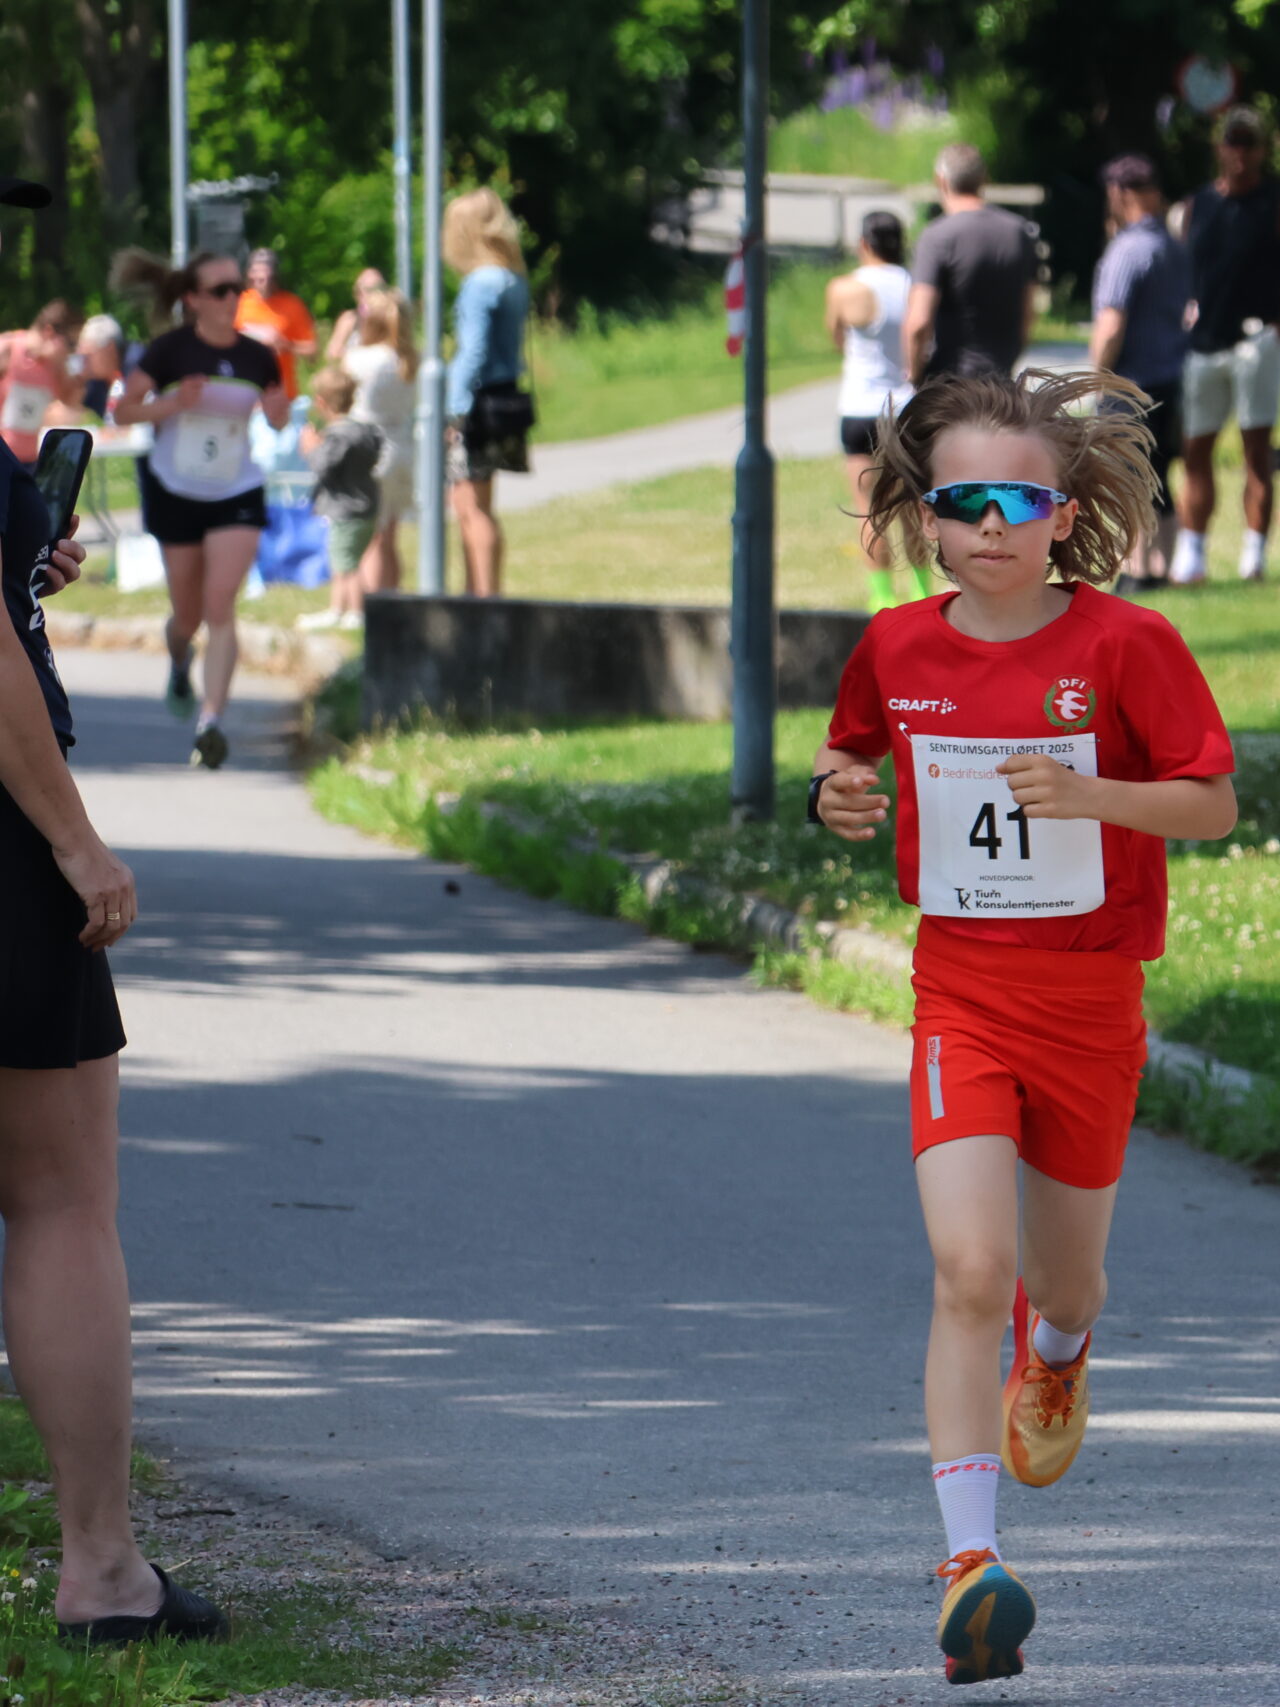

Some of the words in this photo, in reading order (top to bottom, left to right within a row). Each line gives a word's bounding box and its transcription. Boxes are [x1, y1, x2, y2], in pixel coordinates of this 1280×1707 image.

[1058, 678, 1087, 690] DFI
[888, 698, 940, 712] CRAFT
[929, 742, 1046, 756] SENTRUMSGATELØPET
[1048, 743, 1075, 754] 2025
[969, 802, 1031, 860] 41
[975, 900, 1076, 911] Konsulenttjenester
